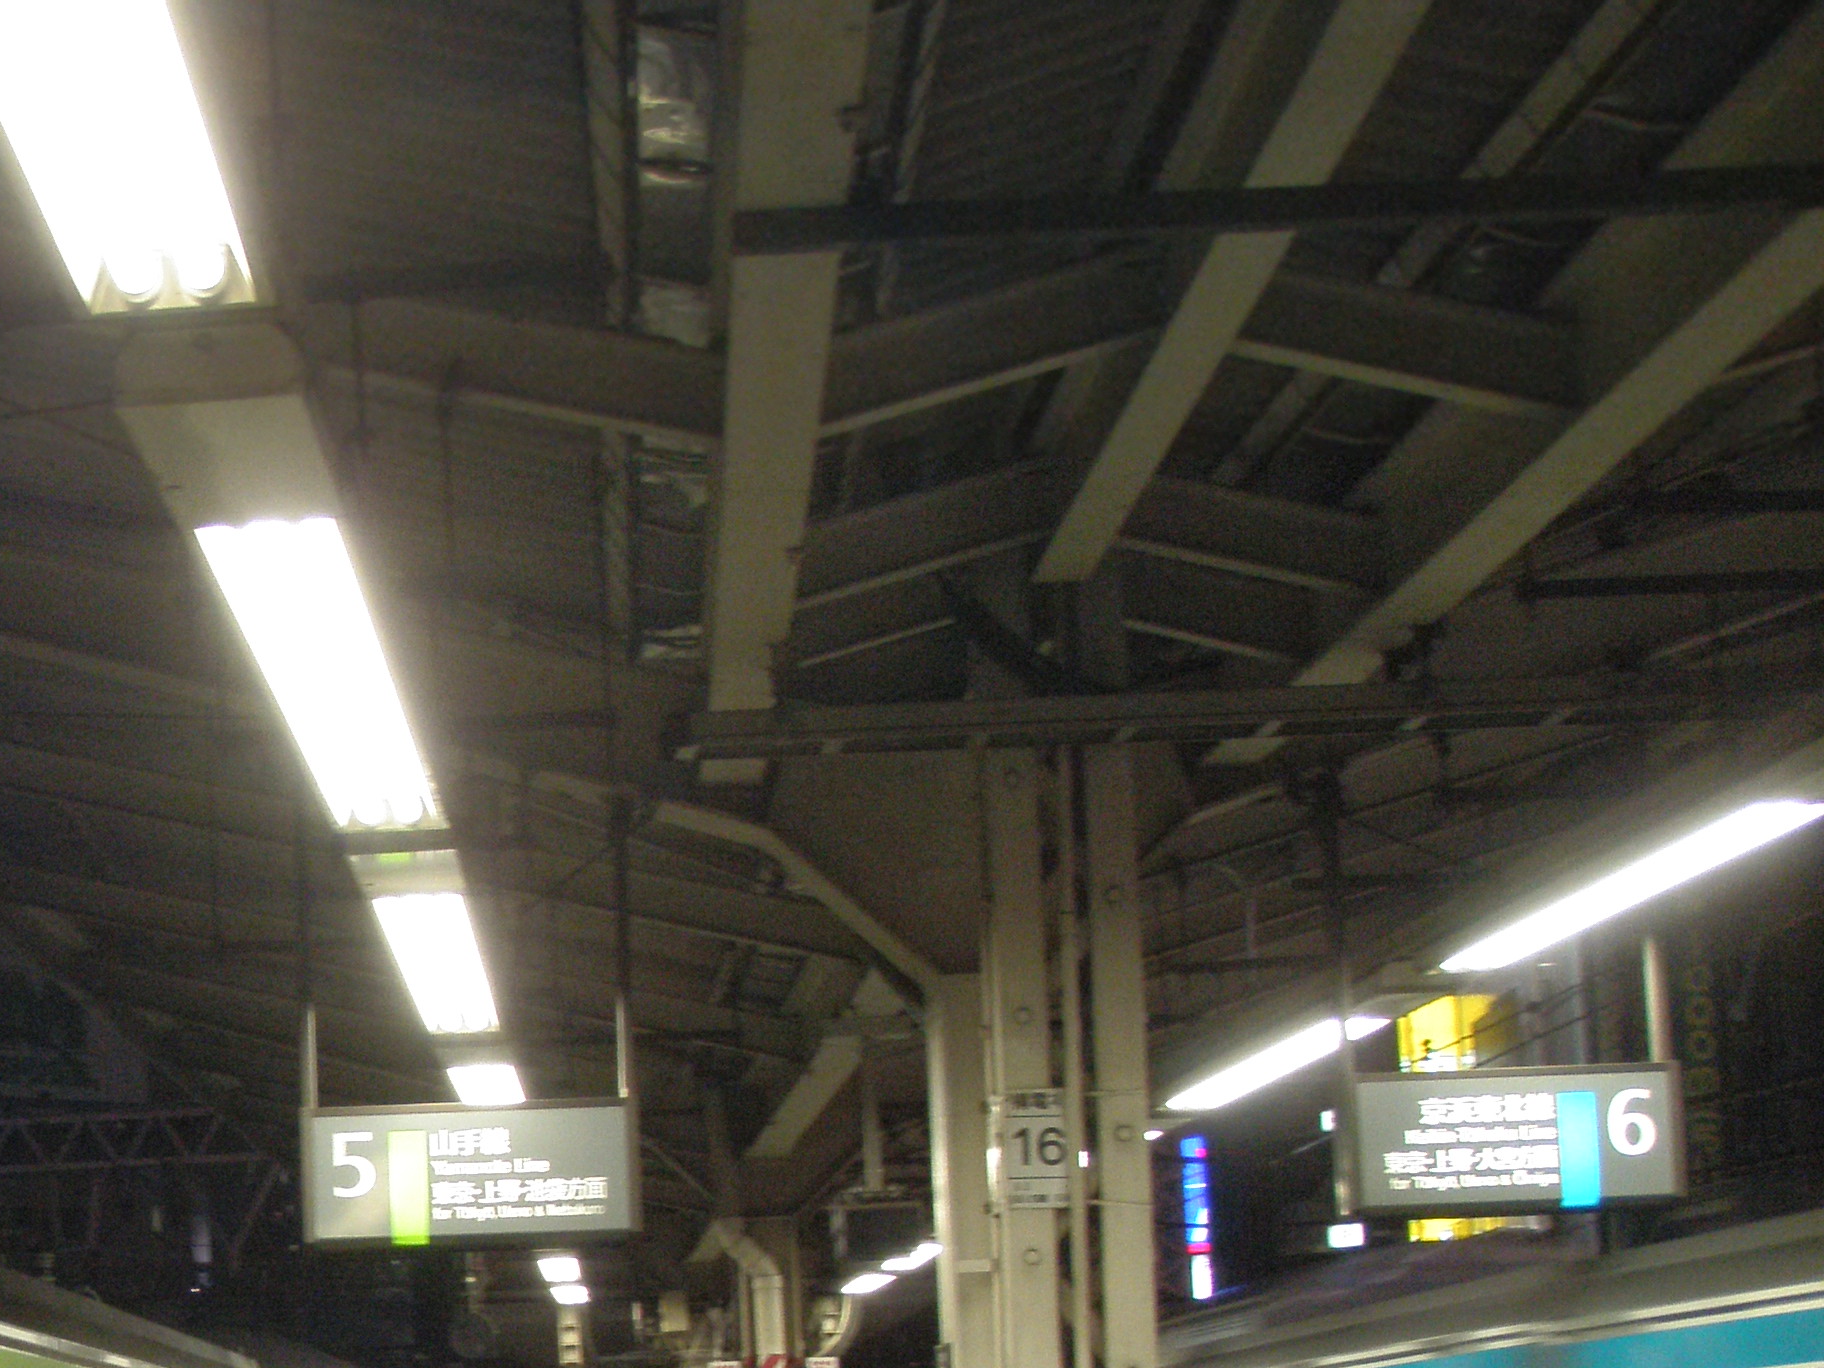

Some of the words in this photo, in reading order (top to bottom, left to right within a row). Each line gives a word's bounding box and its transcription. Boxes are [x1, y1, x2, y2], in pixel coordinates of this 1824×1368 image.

[1607, 1088, 1656, 1156] 6
[429, 1127, 511, 1157] 山手線
[1011, 1127, 1067, 1166] 16
[332, 1131, 377, 1198] 5
[514, 1158, 550, 1172] Line
